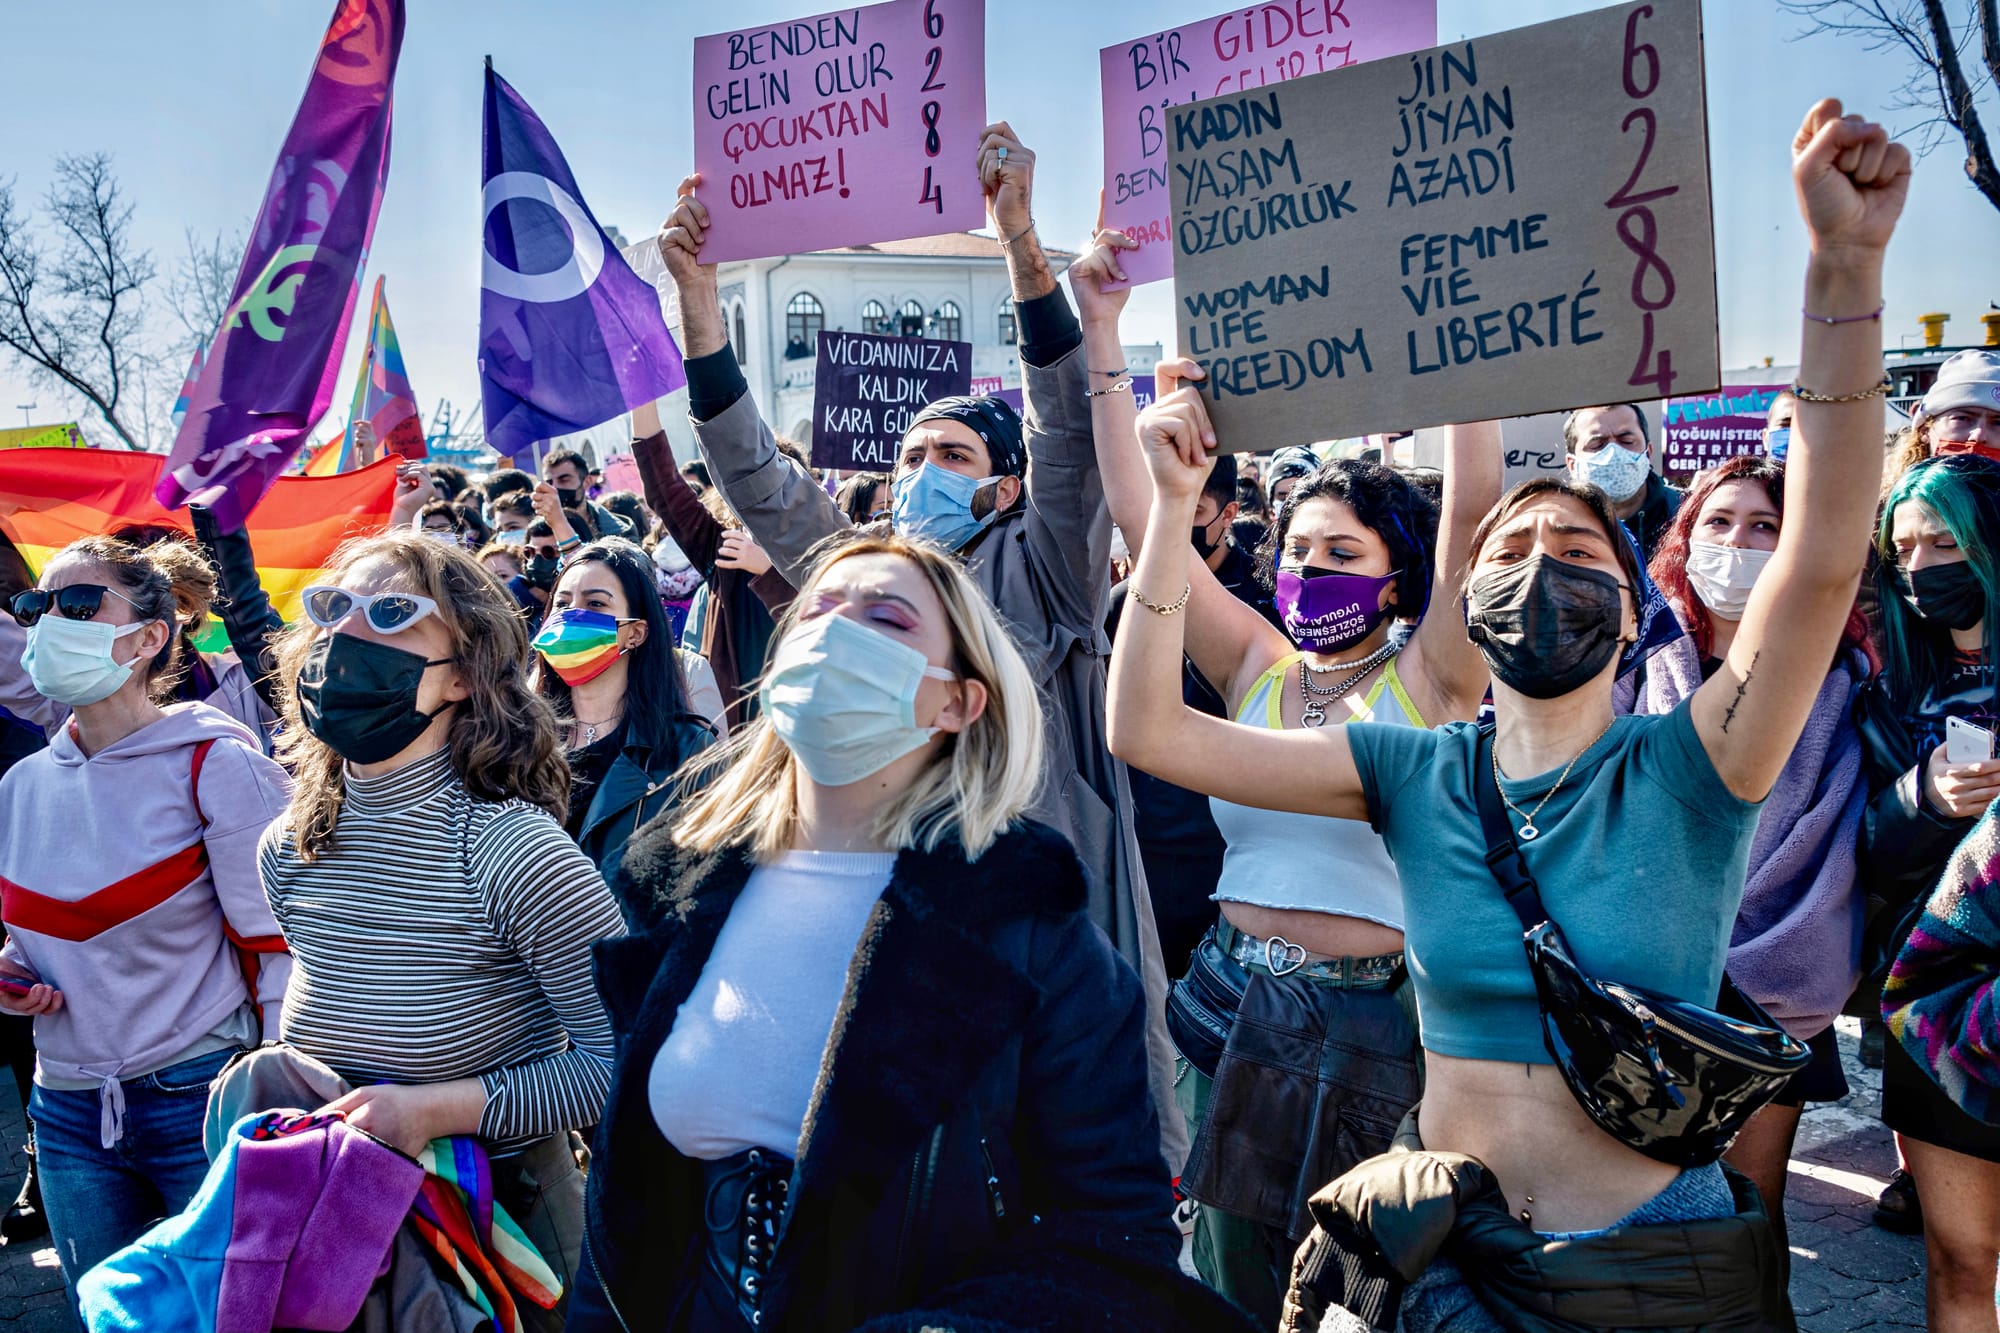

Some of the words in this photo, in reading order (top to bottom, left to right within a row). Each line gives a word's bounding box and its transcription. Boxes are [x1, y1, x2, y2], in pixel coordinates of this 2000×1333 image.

[727, 10, 860, 71] BENDEN
[1128, 31, 1191, 91] BİR
[706, 69, 791, 120] GELİN
[815, 42, 894, 97] OLUR
[1398, 41, 1478, 105] JIN
[722, 92, 889, 164] ÇOCUKTAN
[1174, 91, 1283, 152] KADIN
[730, 147, 851, 209] OLMAZ!
[1175, 138, 1302, 206] YAŞAM
[1179, 180, 1358, 256] ÖZGÜRLÜK
[1400, 214, 1549, 276] FEMME
[1184, 265, 1329, 318] WOMAN
[1401, 268, 1480, 316] VIE
[826, 333, 959, 373] VİCDANINIZA
[1190, 309, 1268, 355] LIFE
[1407, 269, 1604, 376] LIBERTÉ
[824, 405, 874, 434] KARA
[859, 374, 929, 405] KALDIK
[1669, 426, 1720, 441] YOĞUN
